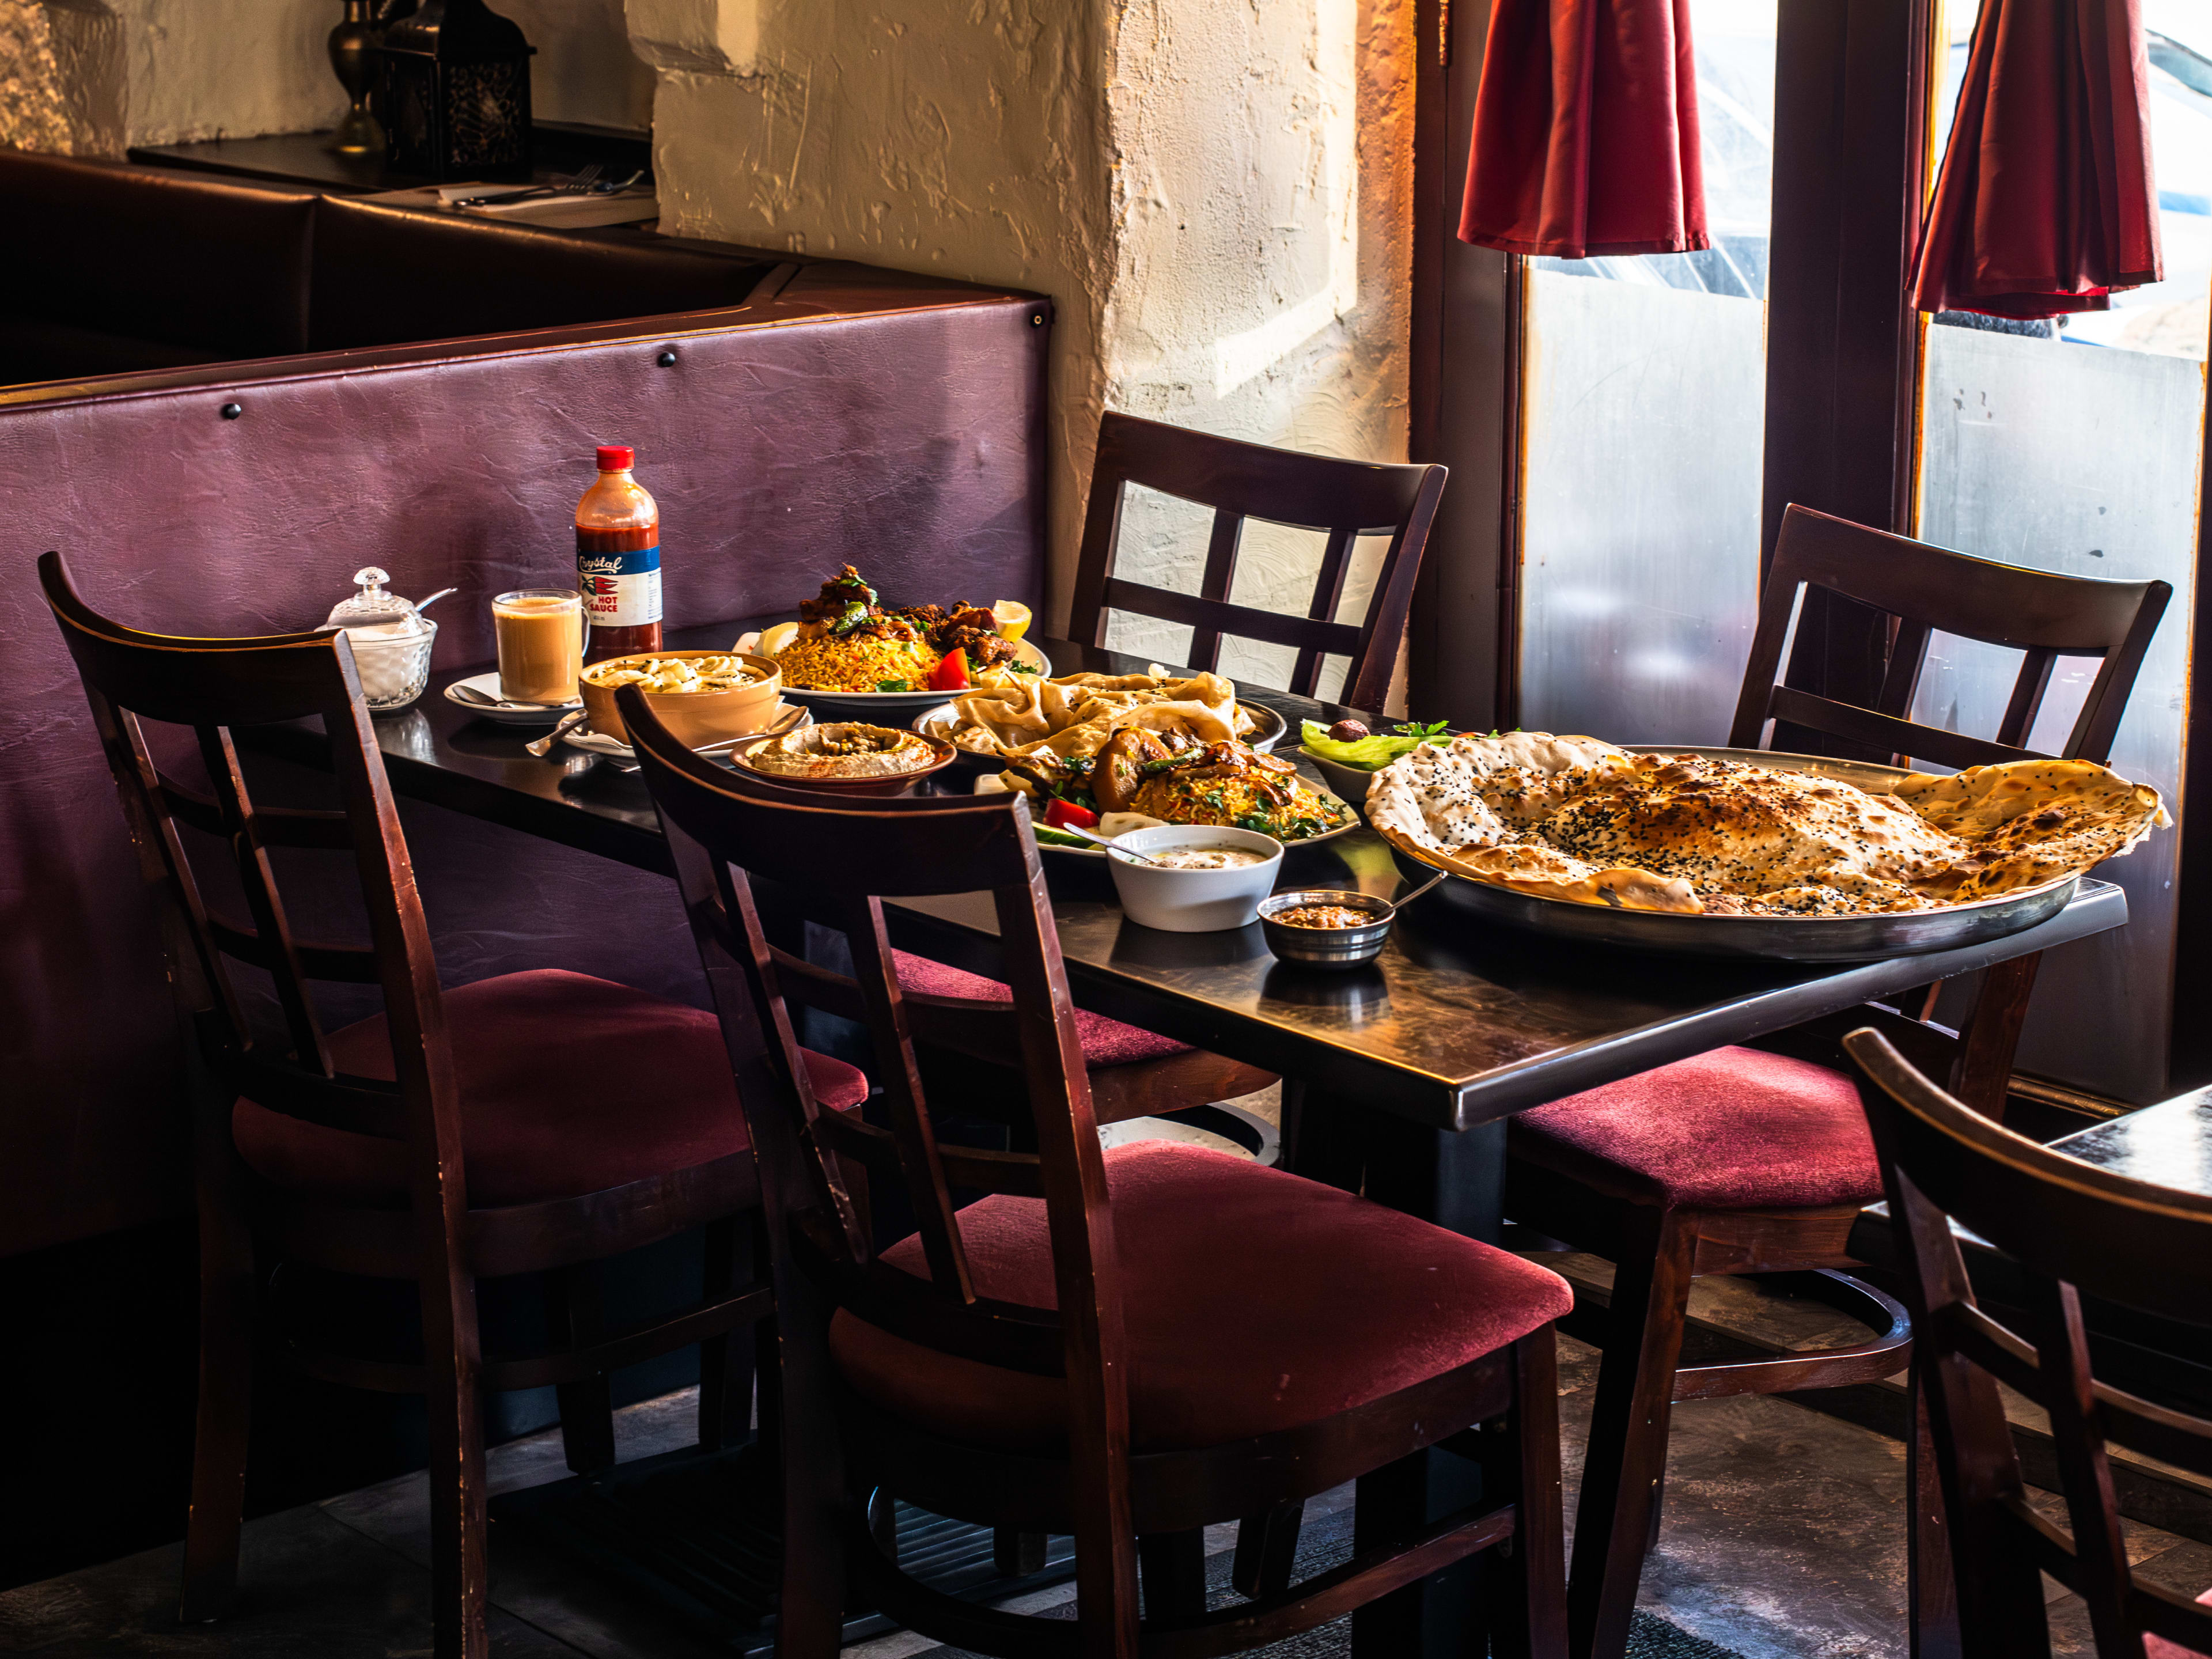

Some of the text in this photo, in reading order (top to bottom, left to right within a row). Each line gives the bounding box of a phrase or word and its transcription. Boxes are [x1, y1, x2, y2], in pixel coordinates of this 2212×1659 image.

[579, 556, 622, 574] Crystal
[599, 596, 618, 604] HOT
[590, 604, 618, 612] SAUCE
